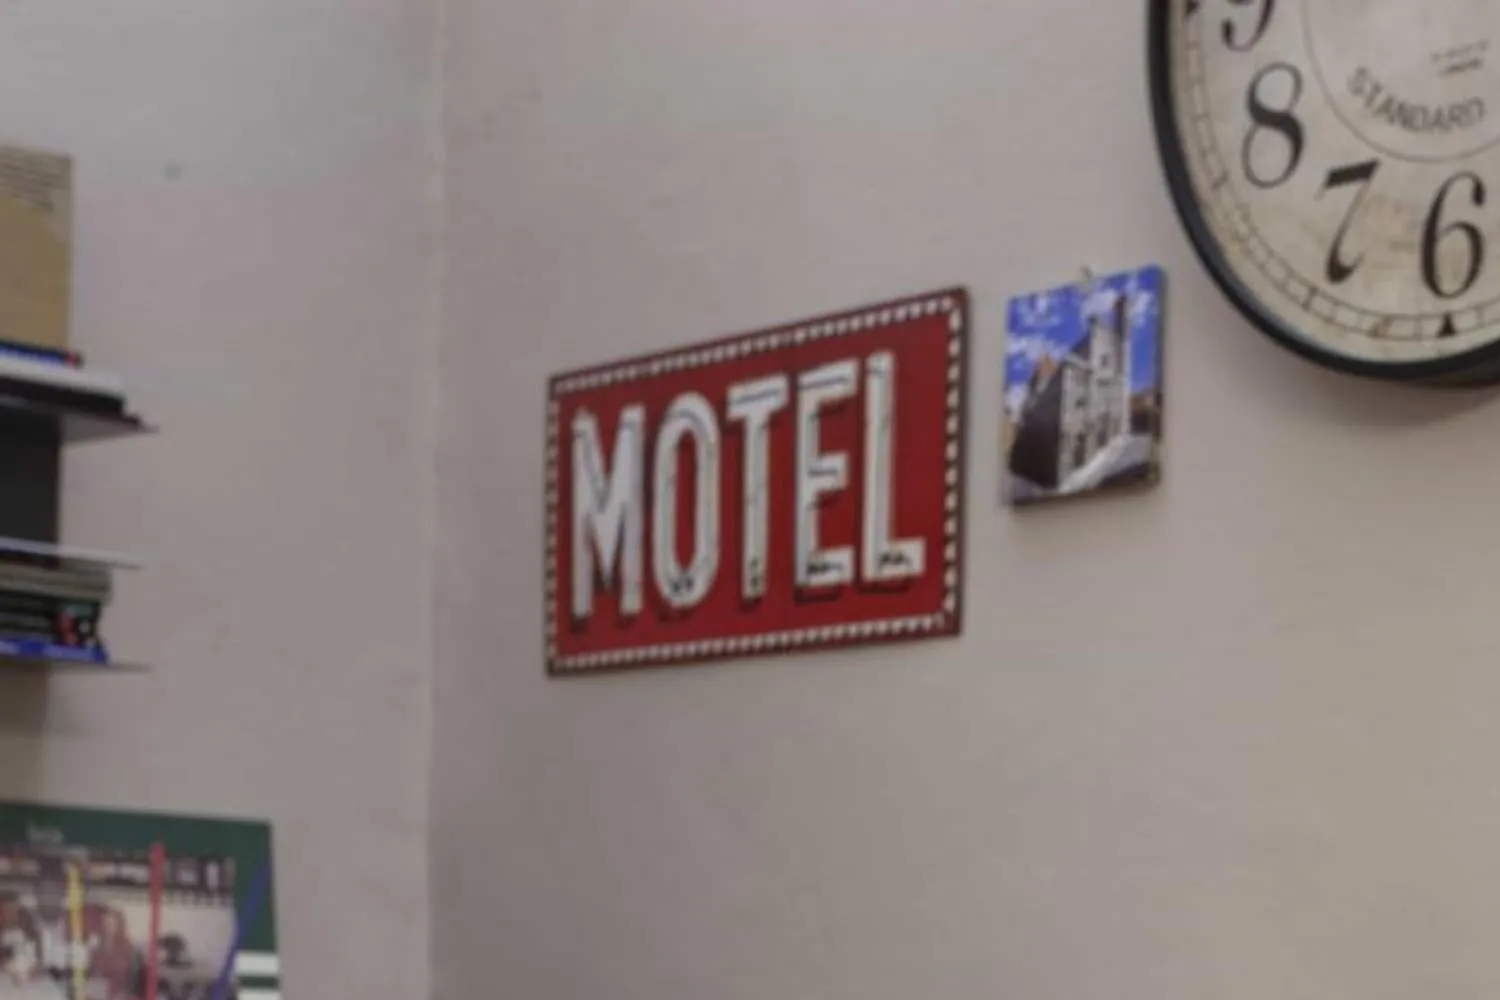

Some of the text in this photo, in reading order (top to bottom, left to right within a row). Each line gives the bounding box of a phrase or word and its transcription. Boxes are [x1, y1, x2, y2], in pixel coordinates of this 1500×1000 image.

[1241, 62, 1305, 189] 8
[1347, 65, 1487, 131] STANDARD
[1316, 157, 1381, 284] 7
[1420, 171, 1486, 299] 6
[571, 350, 926, 618] MOTEL
